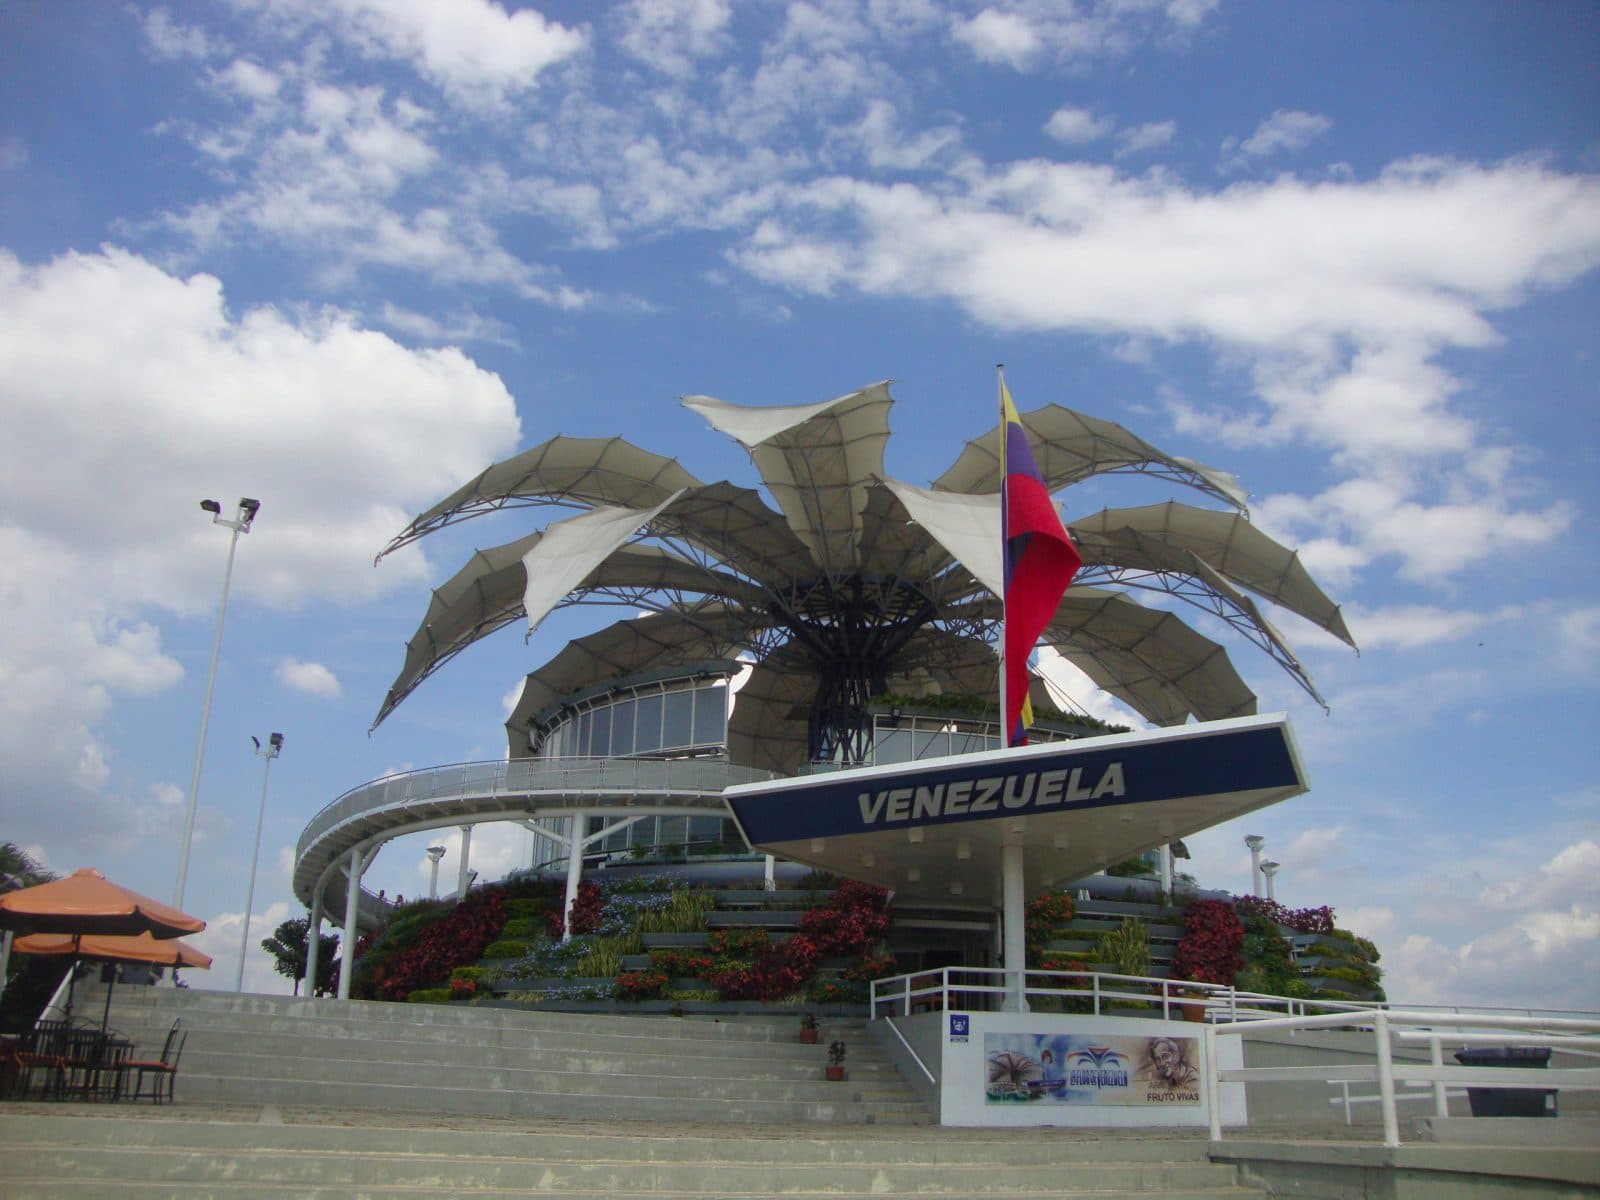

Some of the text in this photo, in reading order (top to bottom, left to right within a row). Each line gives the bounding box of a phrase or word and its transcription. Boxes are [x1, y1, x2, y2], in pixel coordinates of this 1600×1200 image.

[857, 762, 1126, 824] VENEZUELA
[1147, 1092, 1200, 1102] FRUTO VIVAS
